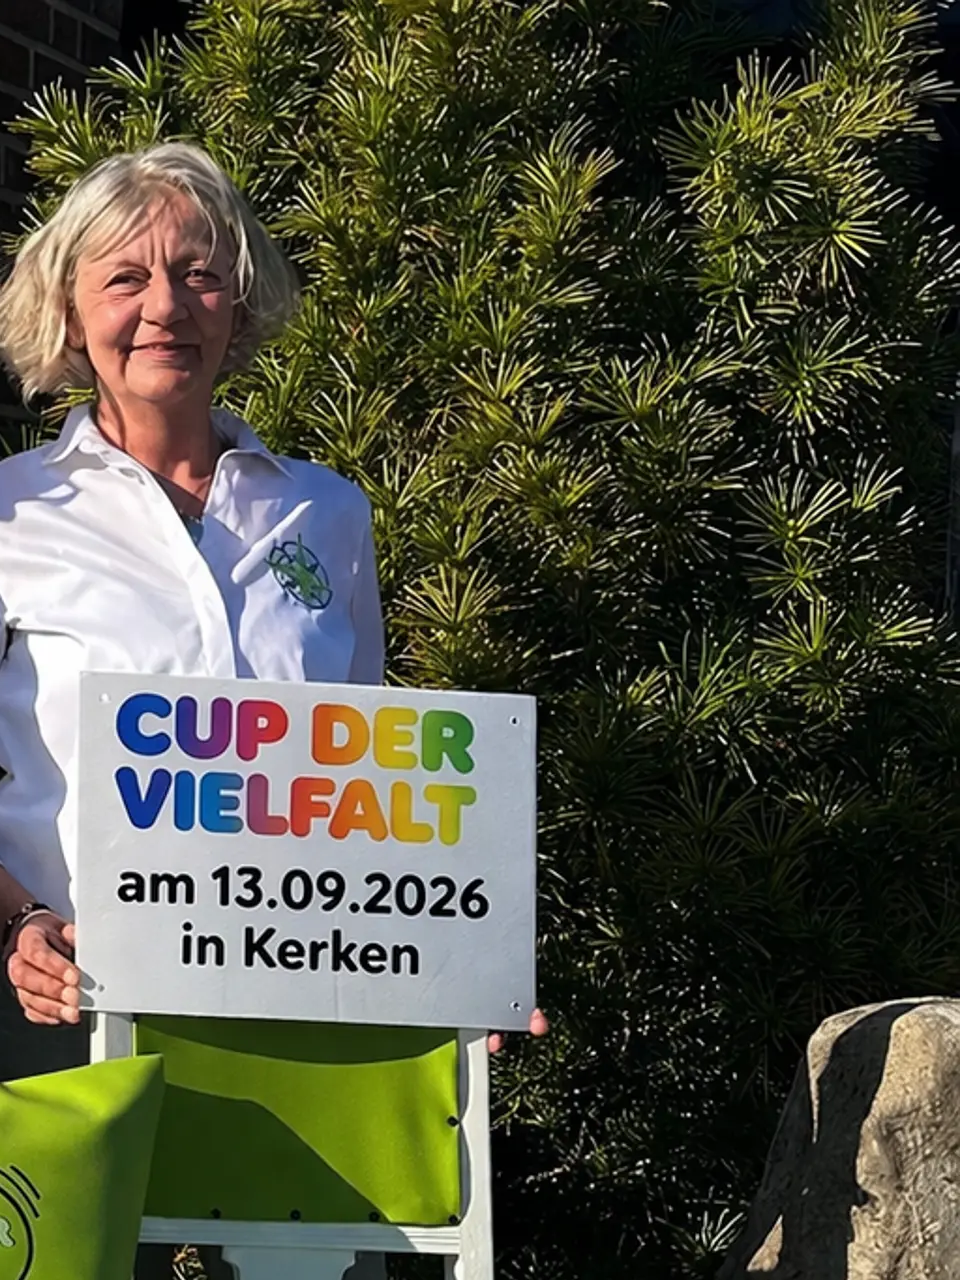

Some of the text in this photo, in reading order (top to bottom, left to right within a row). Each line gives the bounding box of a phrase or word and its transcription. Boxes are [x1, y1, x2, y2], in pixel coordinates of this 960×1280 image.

[116, 692, 474, 773] CUP DER
[115, 766, 477, 845] VIELFALT
[117, 866, 489, 919] am 13.09.2026
[181, 922, 419, 974] in Kerken
